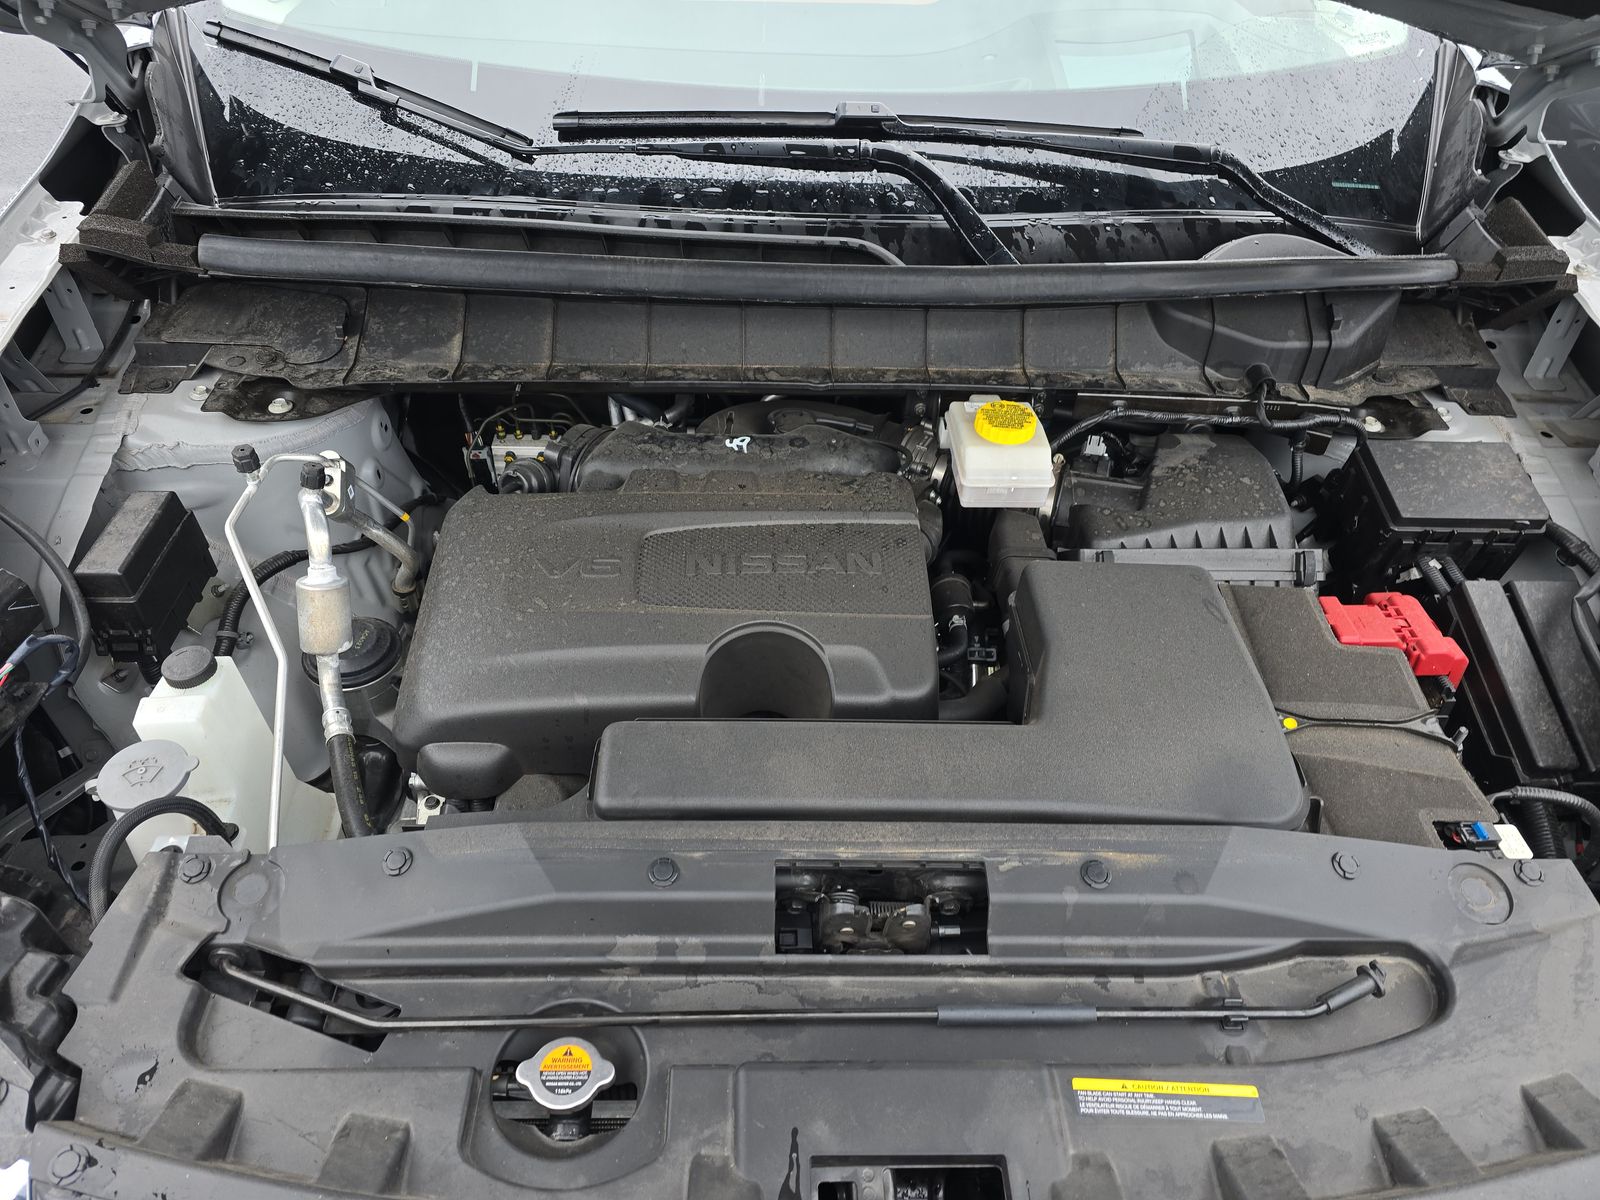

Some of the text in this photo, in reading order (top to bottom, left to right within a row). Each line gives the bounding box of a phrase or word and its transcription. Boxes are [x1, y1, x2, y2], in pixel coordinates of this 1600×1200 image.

[534, 553, 882, 579] V6 NISSAN
[1171, 1085, 1210, 1093] ATTENTION
